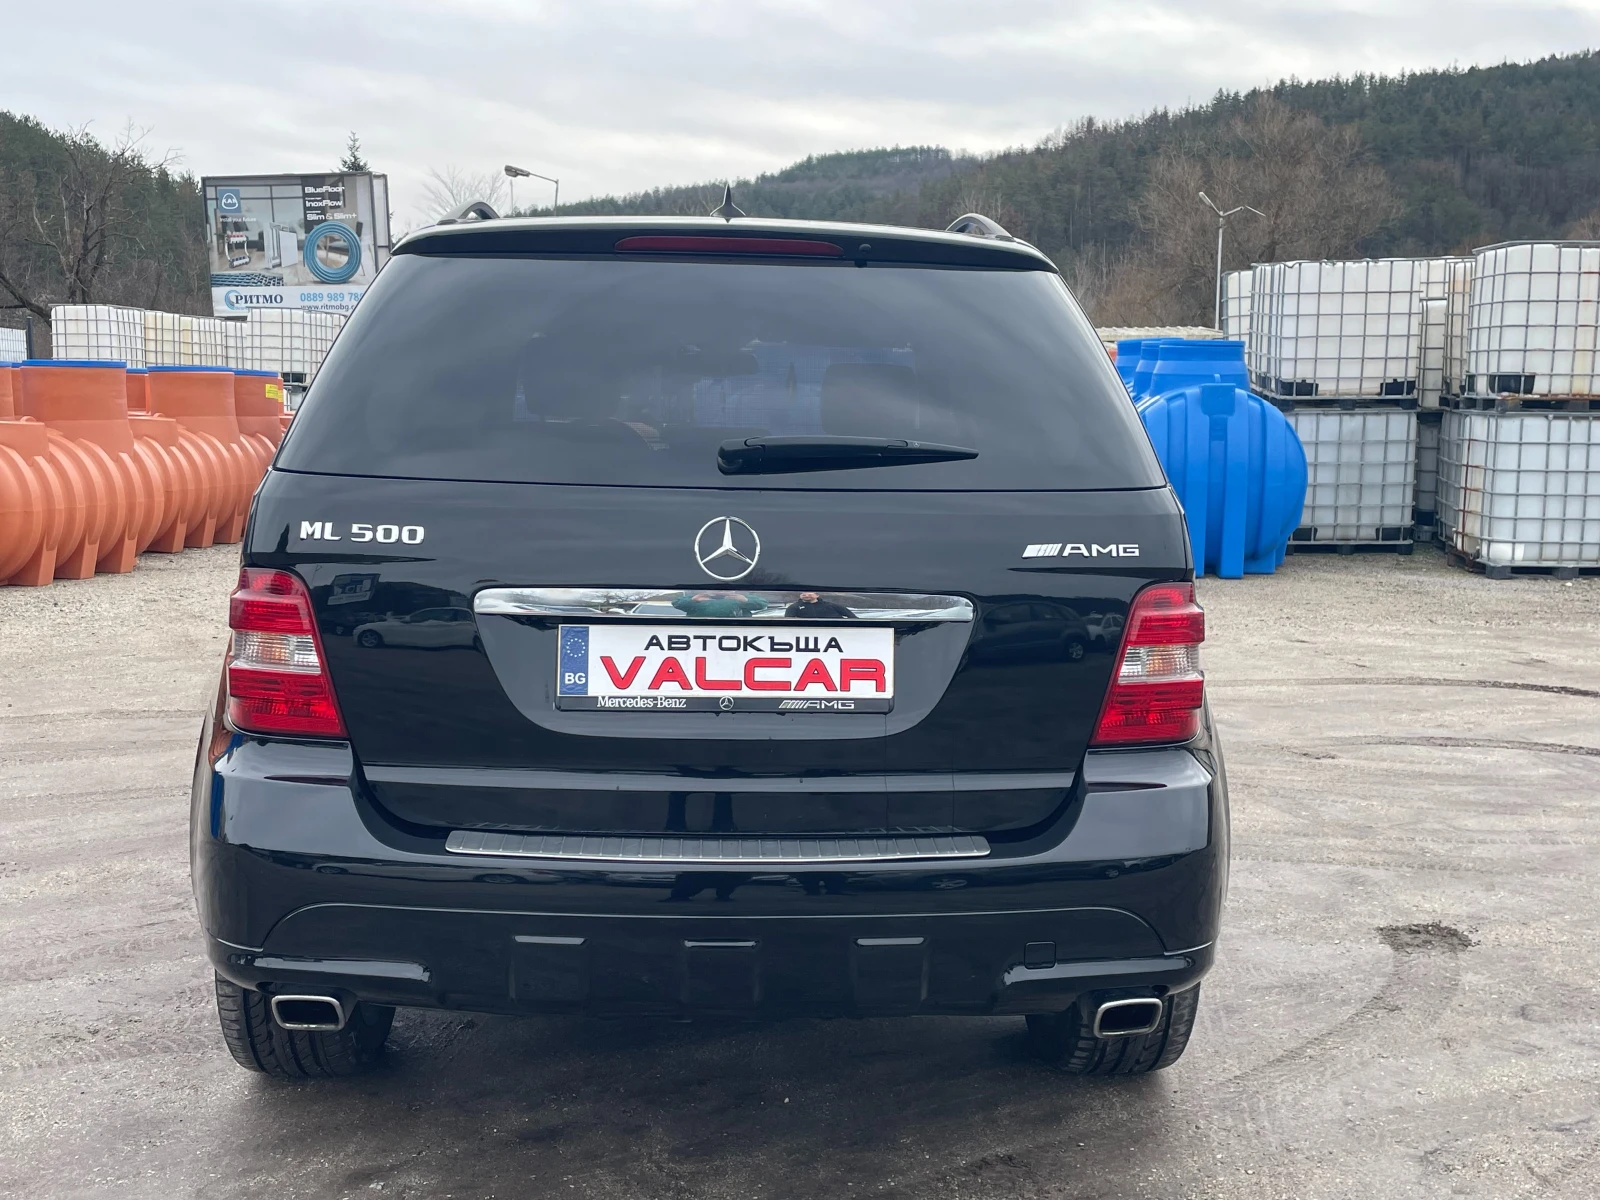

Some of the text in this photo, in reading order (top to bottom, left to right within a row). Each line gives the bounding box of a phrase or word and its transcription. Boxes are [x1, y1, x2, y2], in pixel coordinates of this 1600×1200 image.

[304, 185, 345, 194] BlueFloor
[305, 199, 343, 207] InoxFlow
[306, 212, 357, 221] Slim & Slim+
[234, 293, 284, 304] РИТМО
[300, 292, 324, 302] 0889
[326, 292, 345, 302] 989
[299, 520, 426, 545] ML 500
[1061, 543, 1140, 558] AMG
[643, 634, 844, 653] АВТОКЪЩА
[564, 672, 587, 685] BG
[600, 655, 887, 693] VALCAR
[596, 695, 687, 708] Mercedes-Benz
[804, 700, 856, 710] AMG
